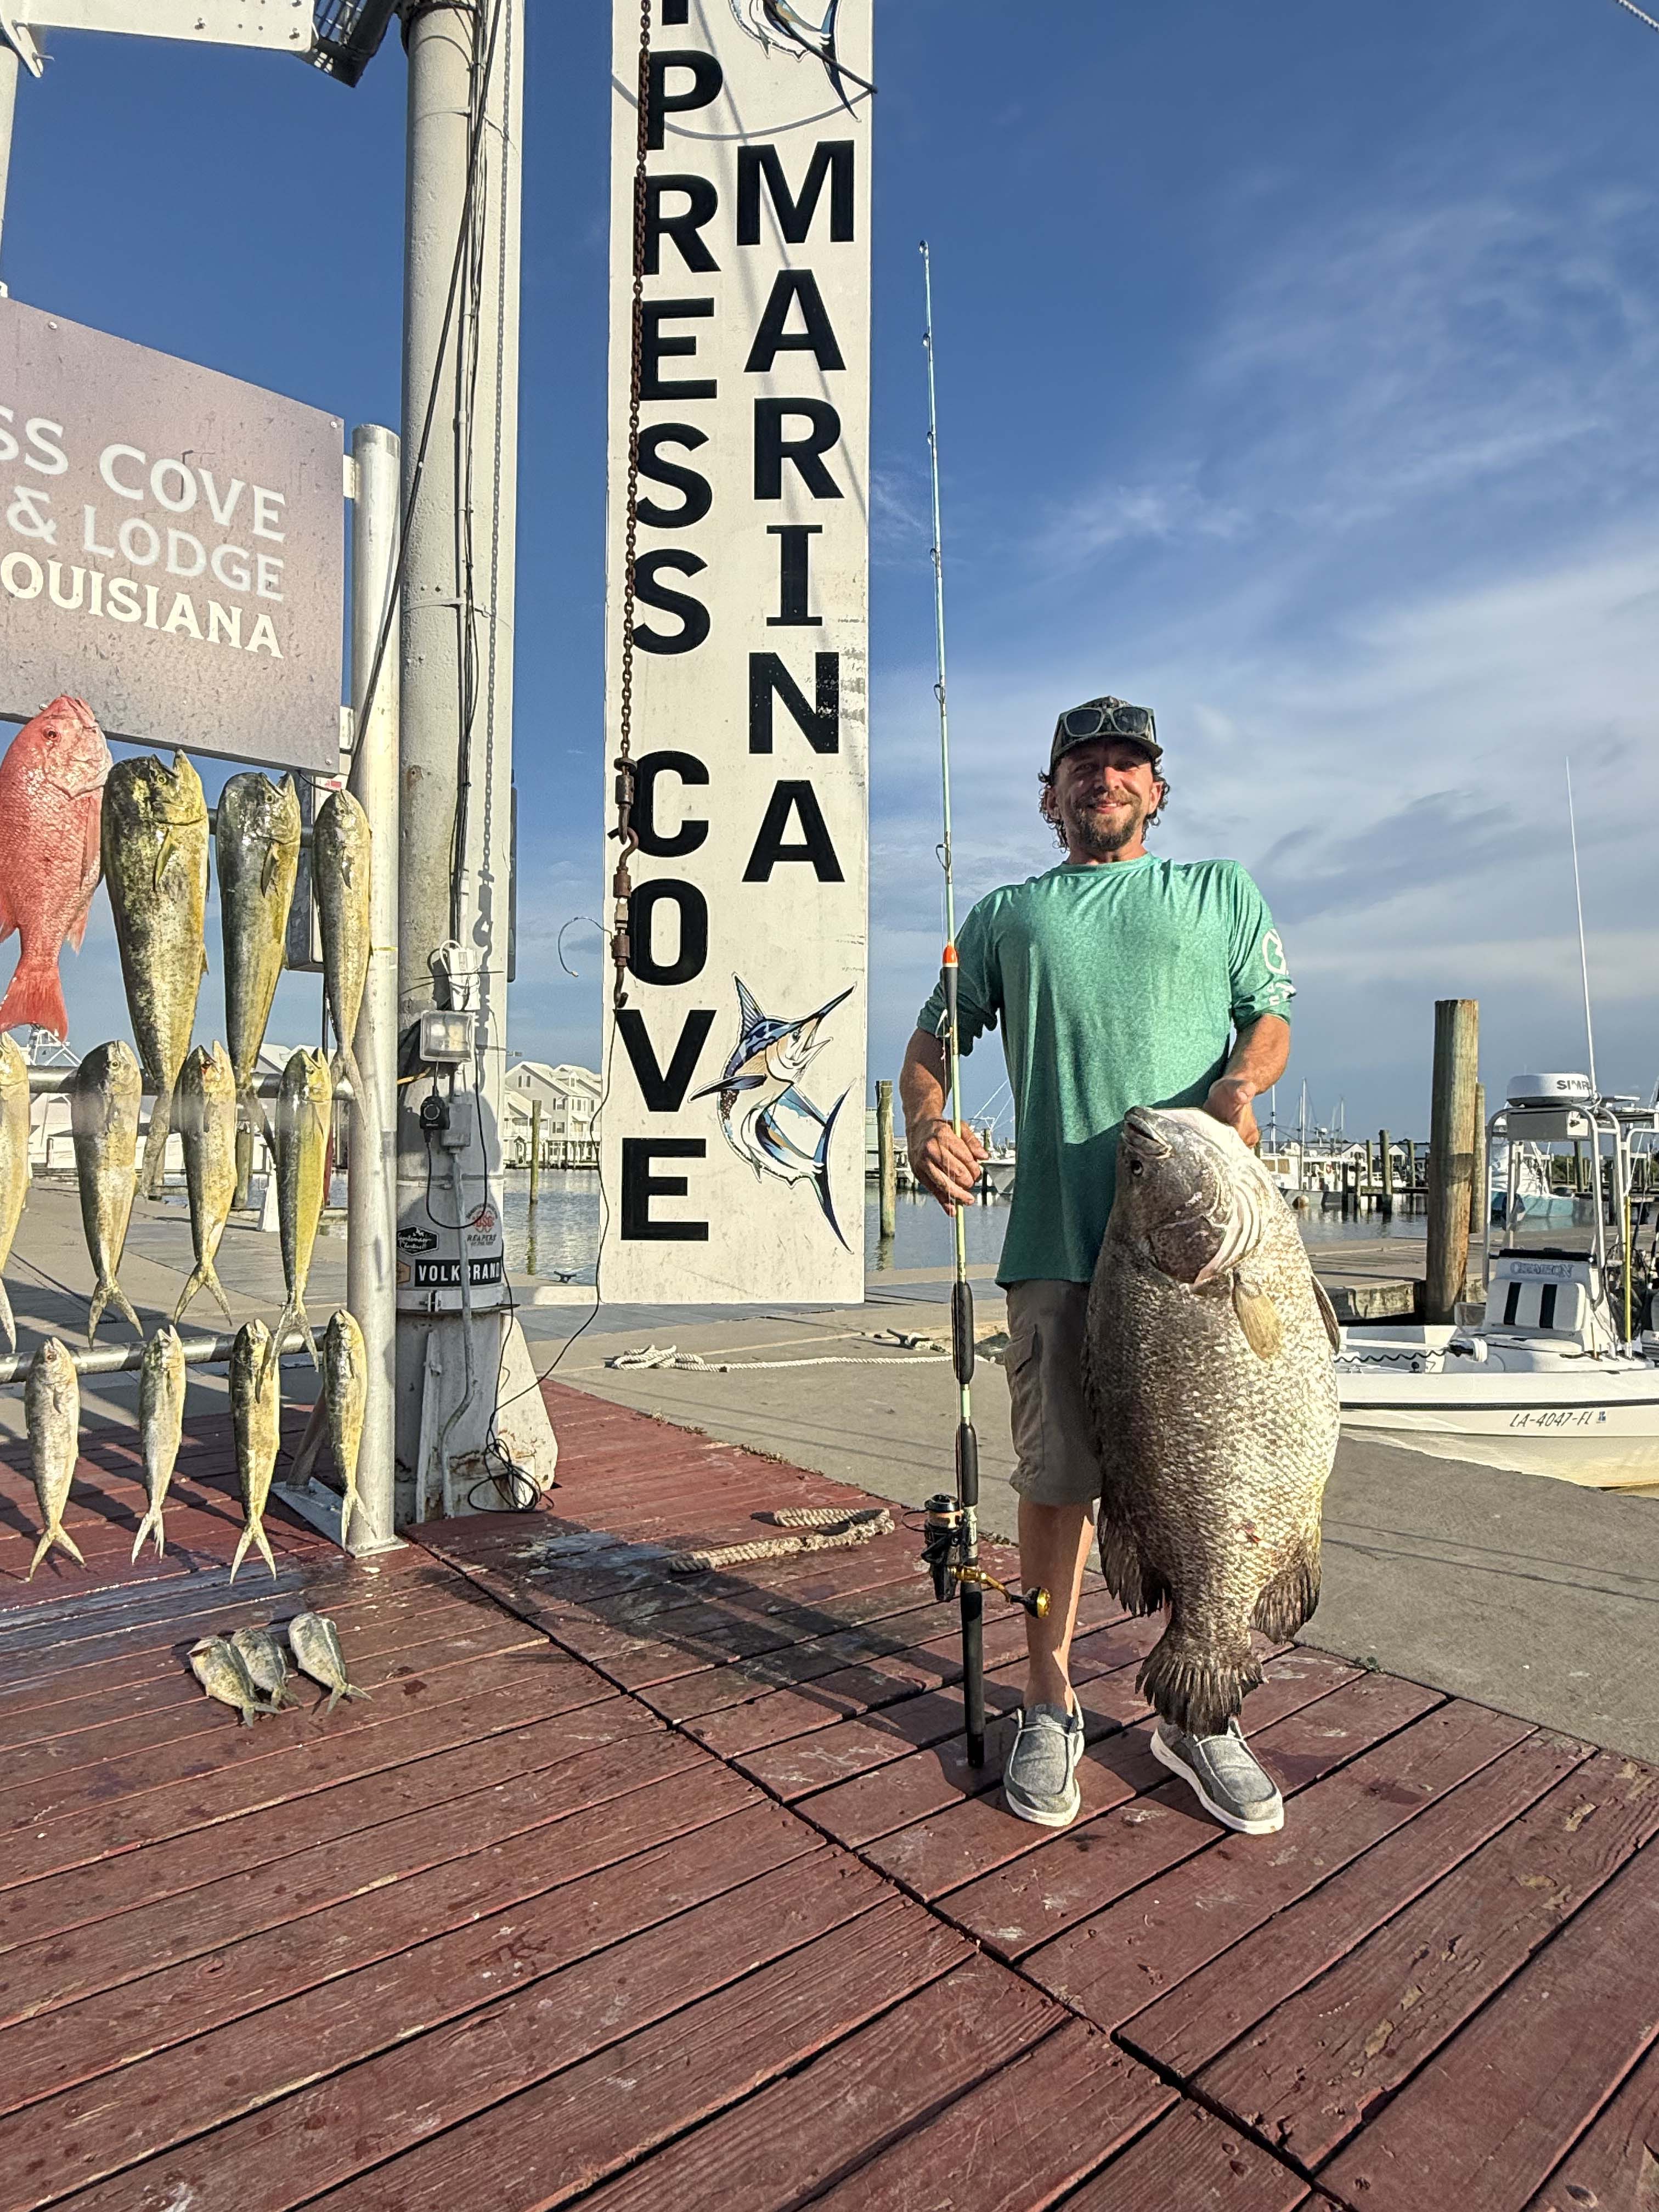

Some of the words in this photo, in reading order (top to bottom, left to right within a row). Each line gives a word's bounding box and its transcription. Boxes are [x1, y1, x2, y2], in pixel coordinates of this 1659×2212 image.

[631, 0, 723, 654] PRESS
[7, 485, 58, 546] &
[83, 504, 285, 602] LODGE
[99, 443, 286, 543] COVE
[736, 139, 855, 883] MARINA
[0, 552, 284, 659] OUISIANA
[614, 751, 716, 1241] COVE
[1509, 1410, 1594, 1427] LA-4047-FL
